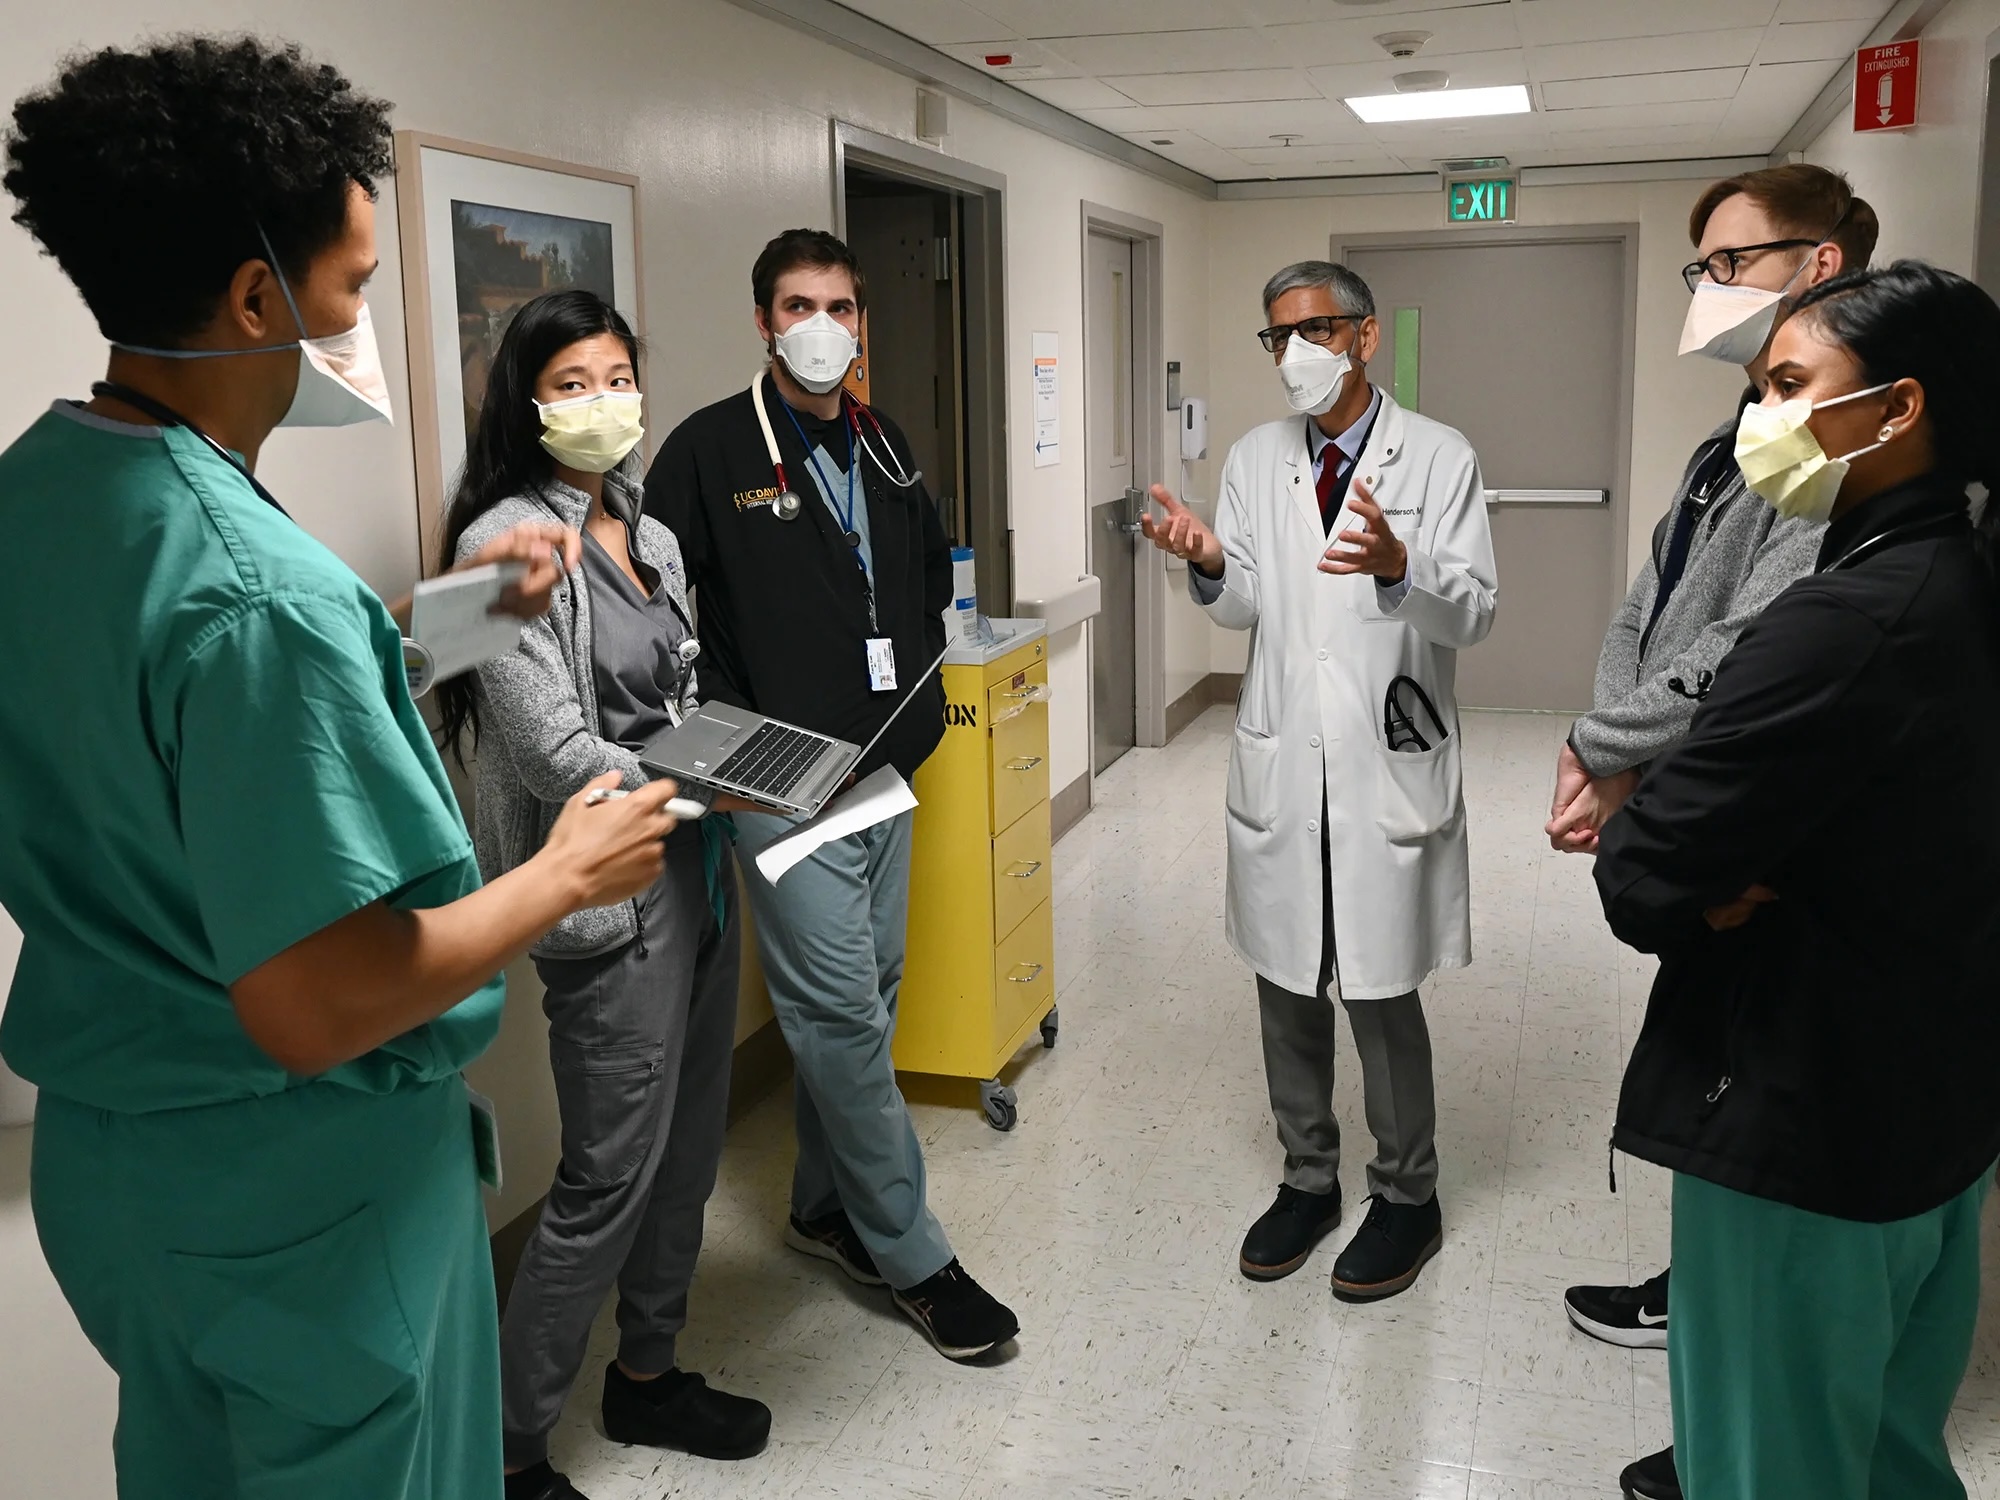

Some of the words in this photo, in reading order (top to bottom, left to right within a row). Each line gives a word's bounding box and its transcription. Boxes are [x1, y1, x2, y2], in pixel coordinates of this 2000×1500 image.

[1875, 46, 1901, 59] FIRE
[1864, 56, 1910, 73] EXTINGUISHER
[1451, 180, 1513, 220] EXIT
[811, 357, 826, 366] 3M
[1382, 508, 1416, 516] Henderson,
[944, 703, 977, 728] ON
